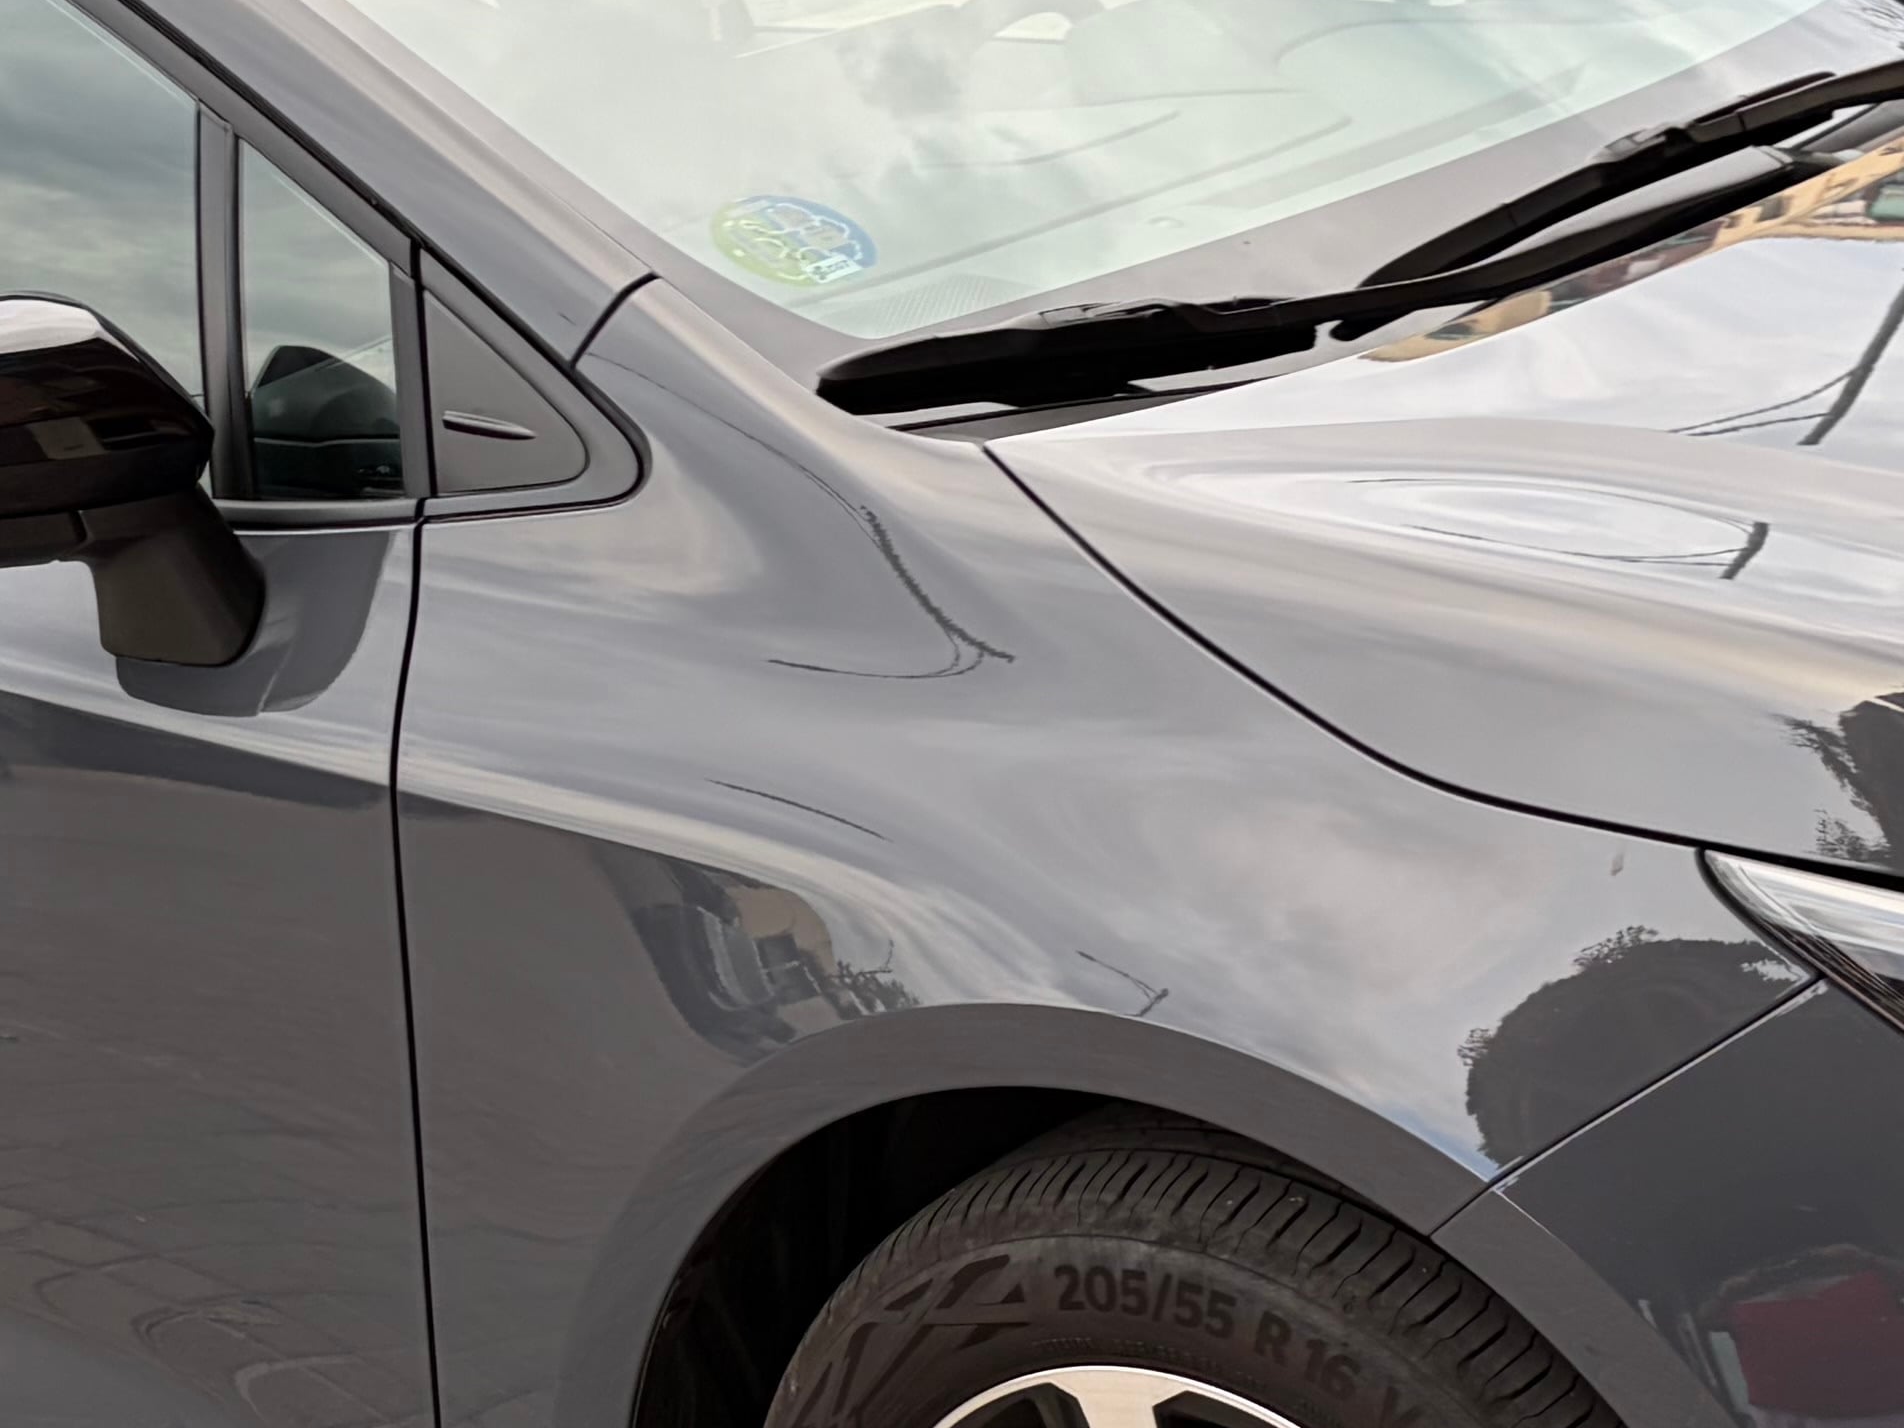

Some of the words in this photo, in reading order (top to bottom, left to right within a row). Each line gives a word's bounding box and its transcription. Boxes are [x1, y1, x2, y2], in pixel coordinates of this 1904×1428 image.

[1053, 1264, 1237, 1339] 205/55
[1254, 1310, 1293, 1368] R
[1302, 1338, 1362, 1402] 16
